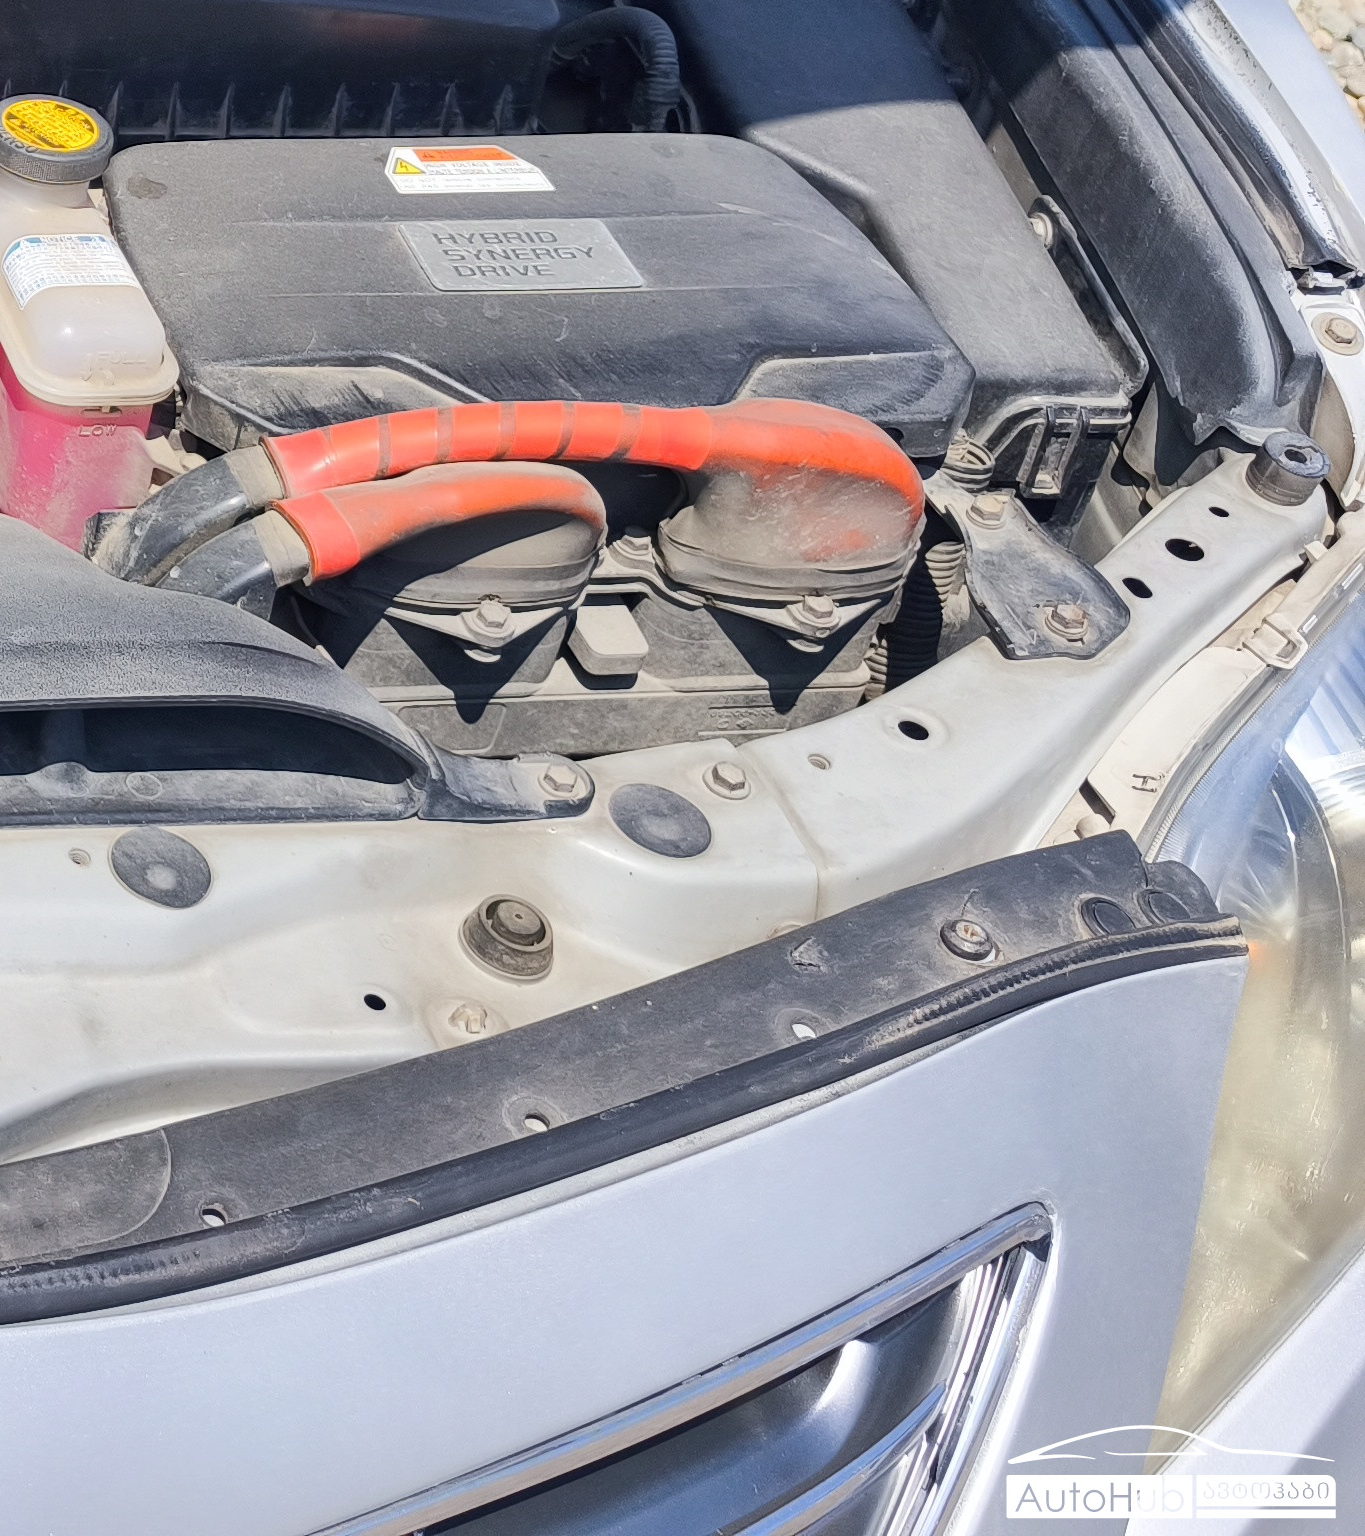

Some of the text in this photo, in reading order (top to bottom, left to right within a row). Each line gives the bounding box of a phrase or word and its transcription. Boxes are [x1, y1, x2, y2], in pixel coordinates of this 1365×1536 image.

[432, 230, 558, 245] HYBRID
[442, 246, 594, 261] SYNERGY
[453, 263, 555, 277] DRIVE
[78, 423, 117, 437] LOW
